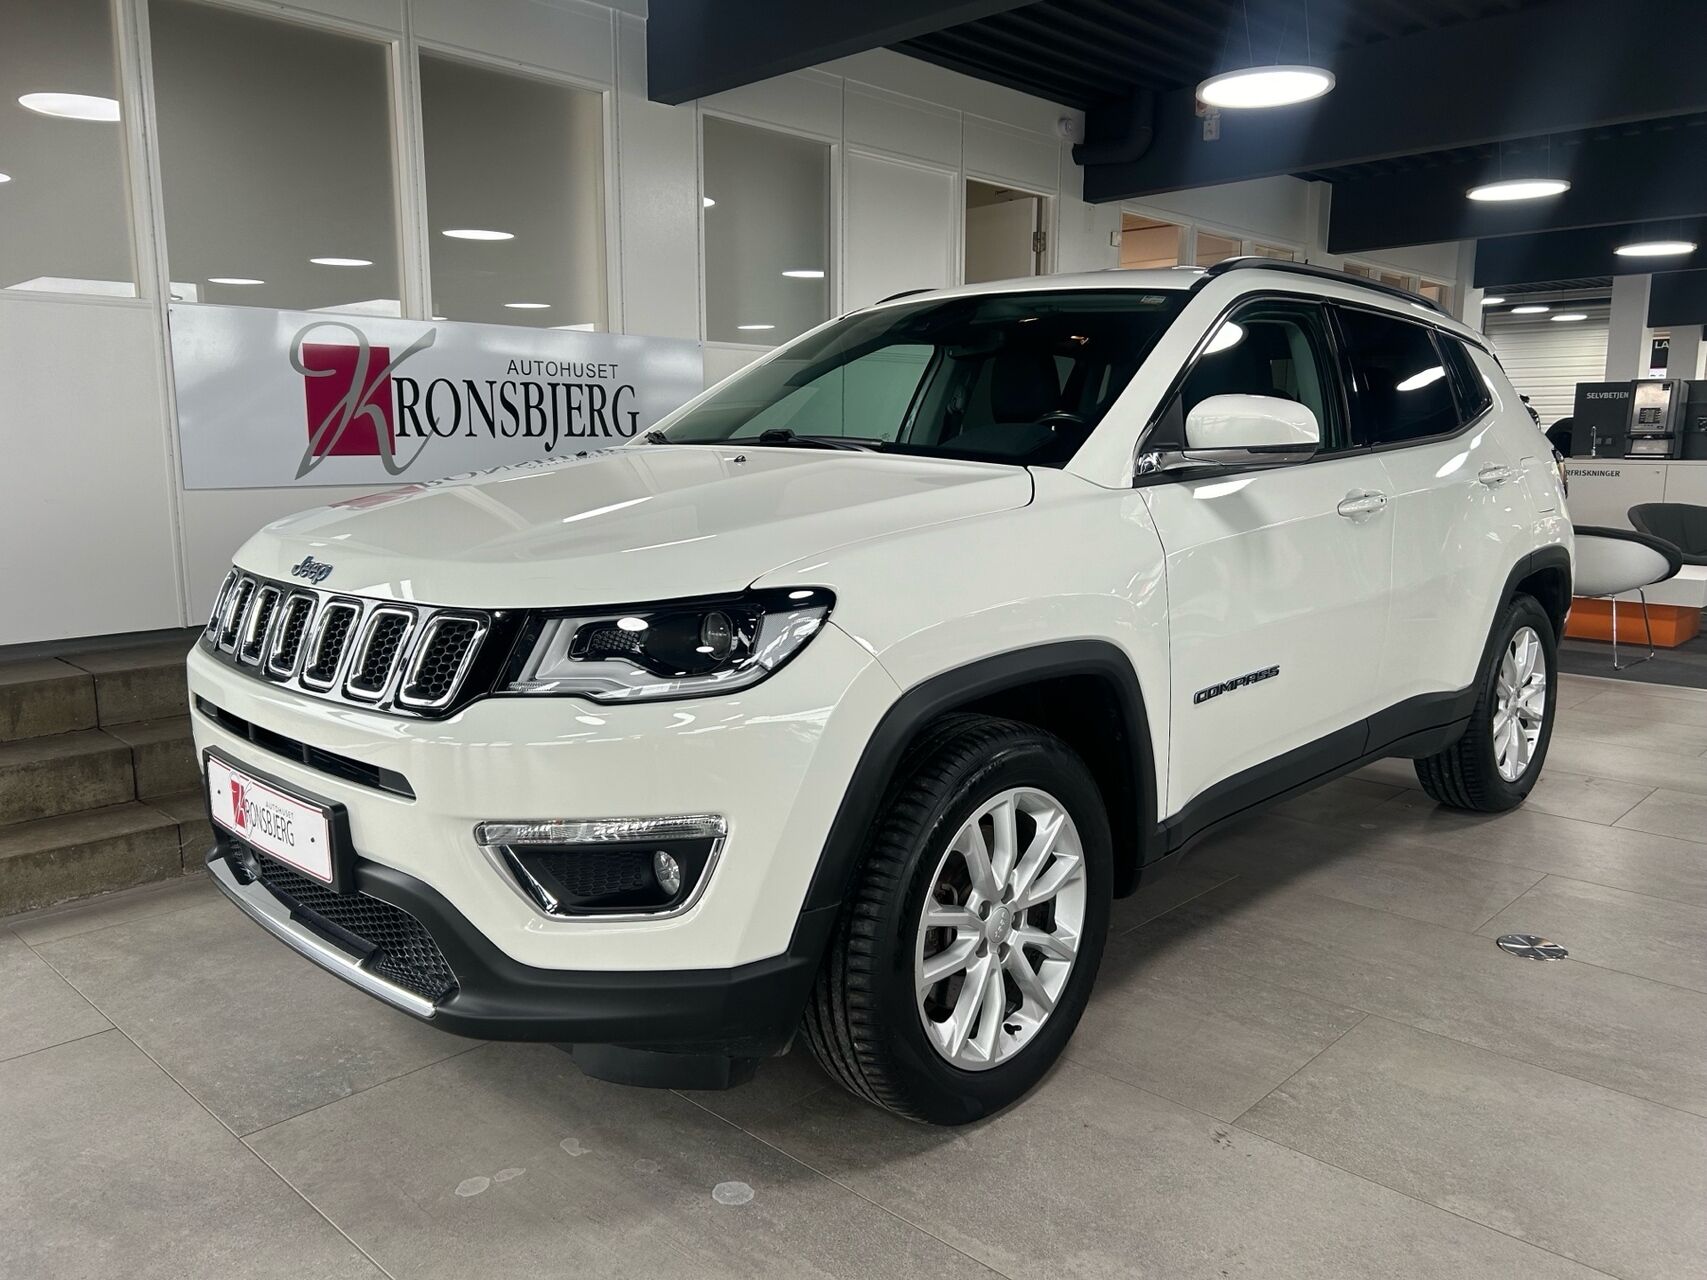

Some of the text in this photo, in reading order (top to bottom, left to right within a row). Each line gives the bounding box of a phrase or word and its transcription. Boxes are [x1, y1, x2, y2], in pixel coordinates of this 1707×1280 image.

[506, 359, 619, 380] AUTOHUSET
[290, 321, 640, 480] KRONSBJERG
[1586, 391, 1629, 399] SELVBETJEN
[291, 556, 333, 585] Jeep
[1193, 664, 1280, 704] COMPASS
